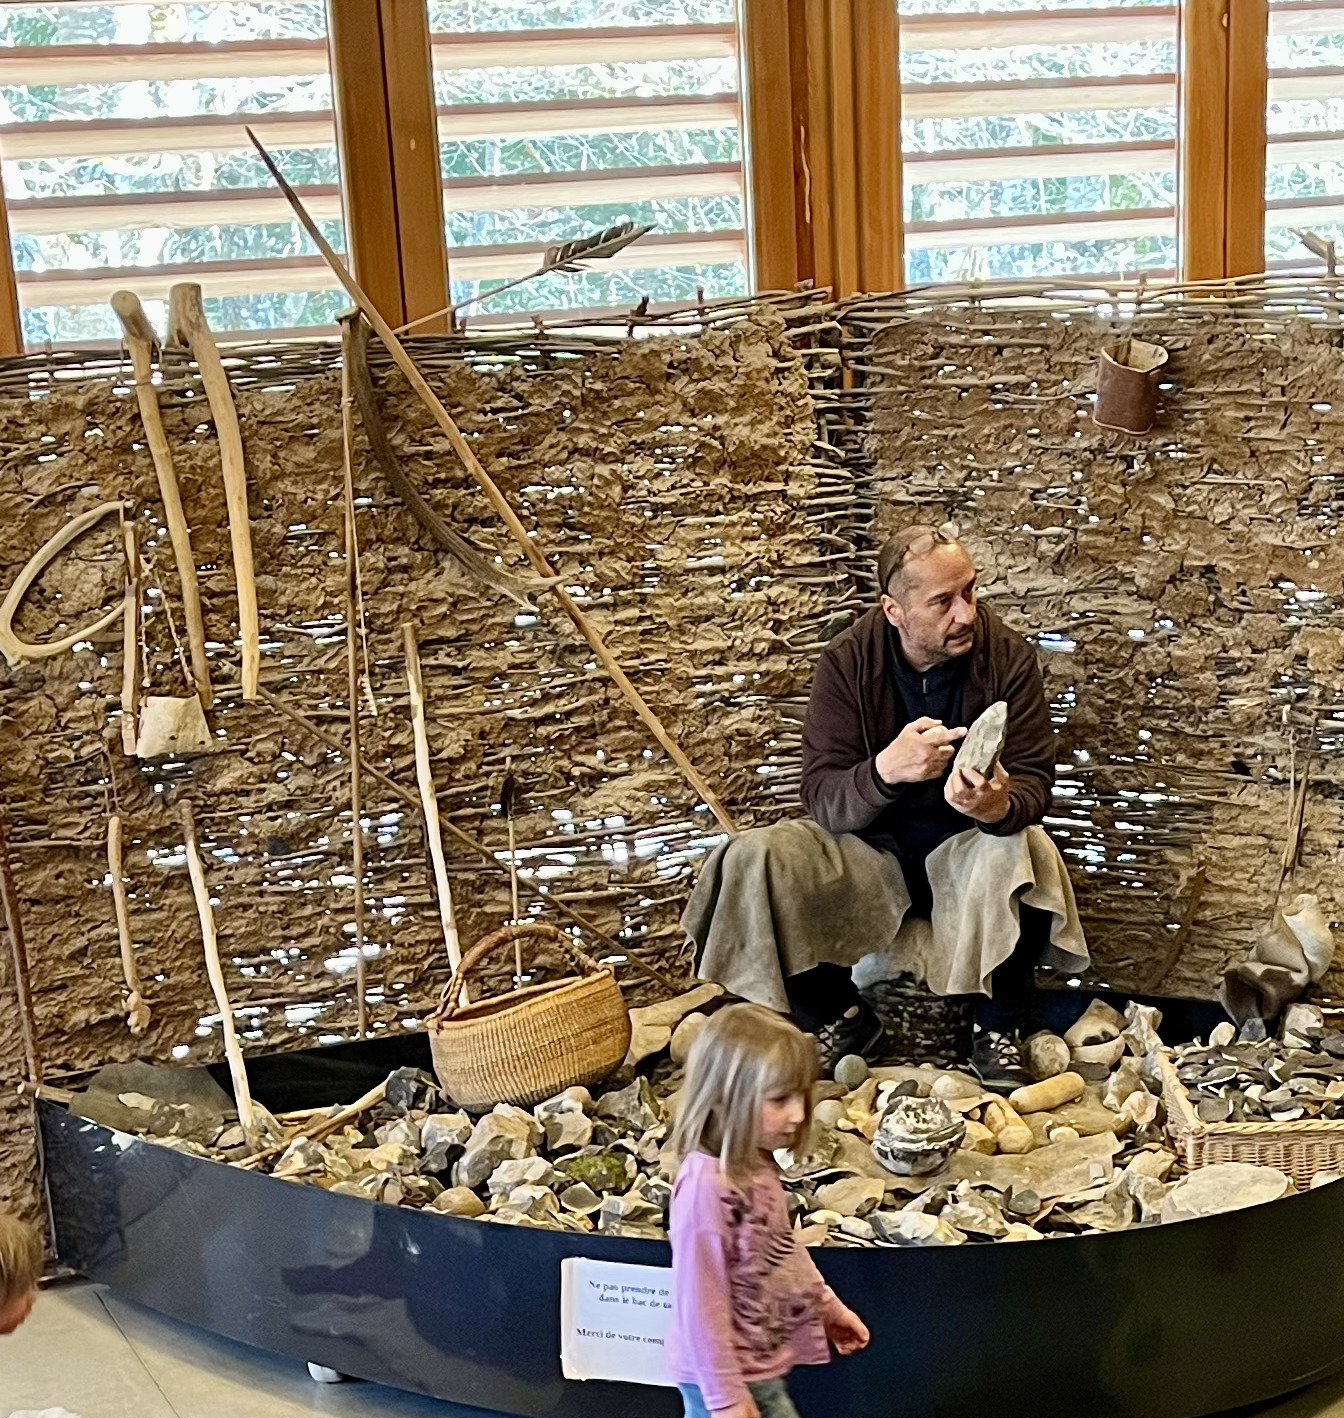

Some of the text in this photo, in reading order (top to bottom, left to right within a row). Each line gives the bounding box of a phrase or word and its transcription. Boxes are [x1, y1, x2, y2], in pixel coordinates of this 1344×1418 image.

[622, 1286, 656, 1294] prendre
[599, 1294, 619, 1303] dans
[632, 1297, 646, 1306] bac
[649, 1299, 660, 1308] de
[576, 1328, 603, 1338] Merci
[606, 1331, 616, 1339] de
[618, 1334, 641, 1342] votre
